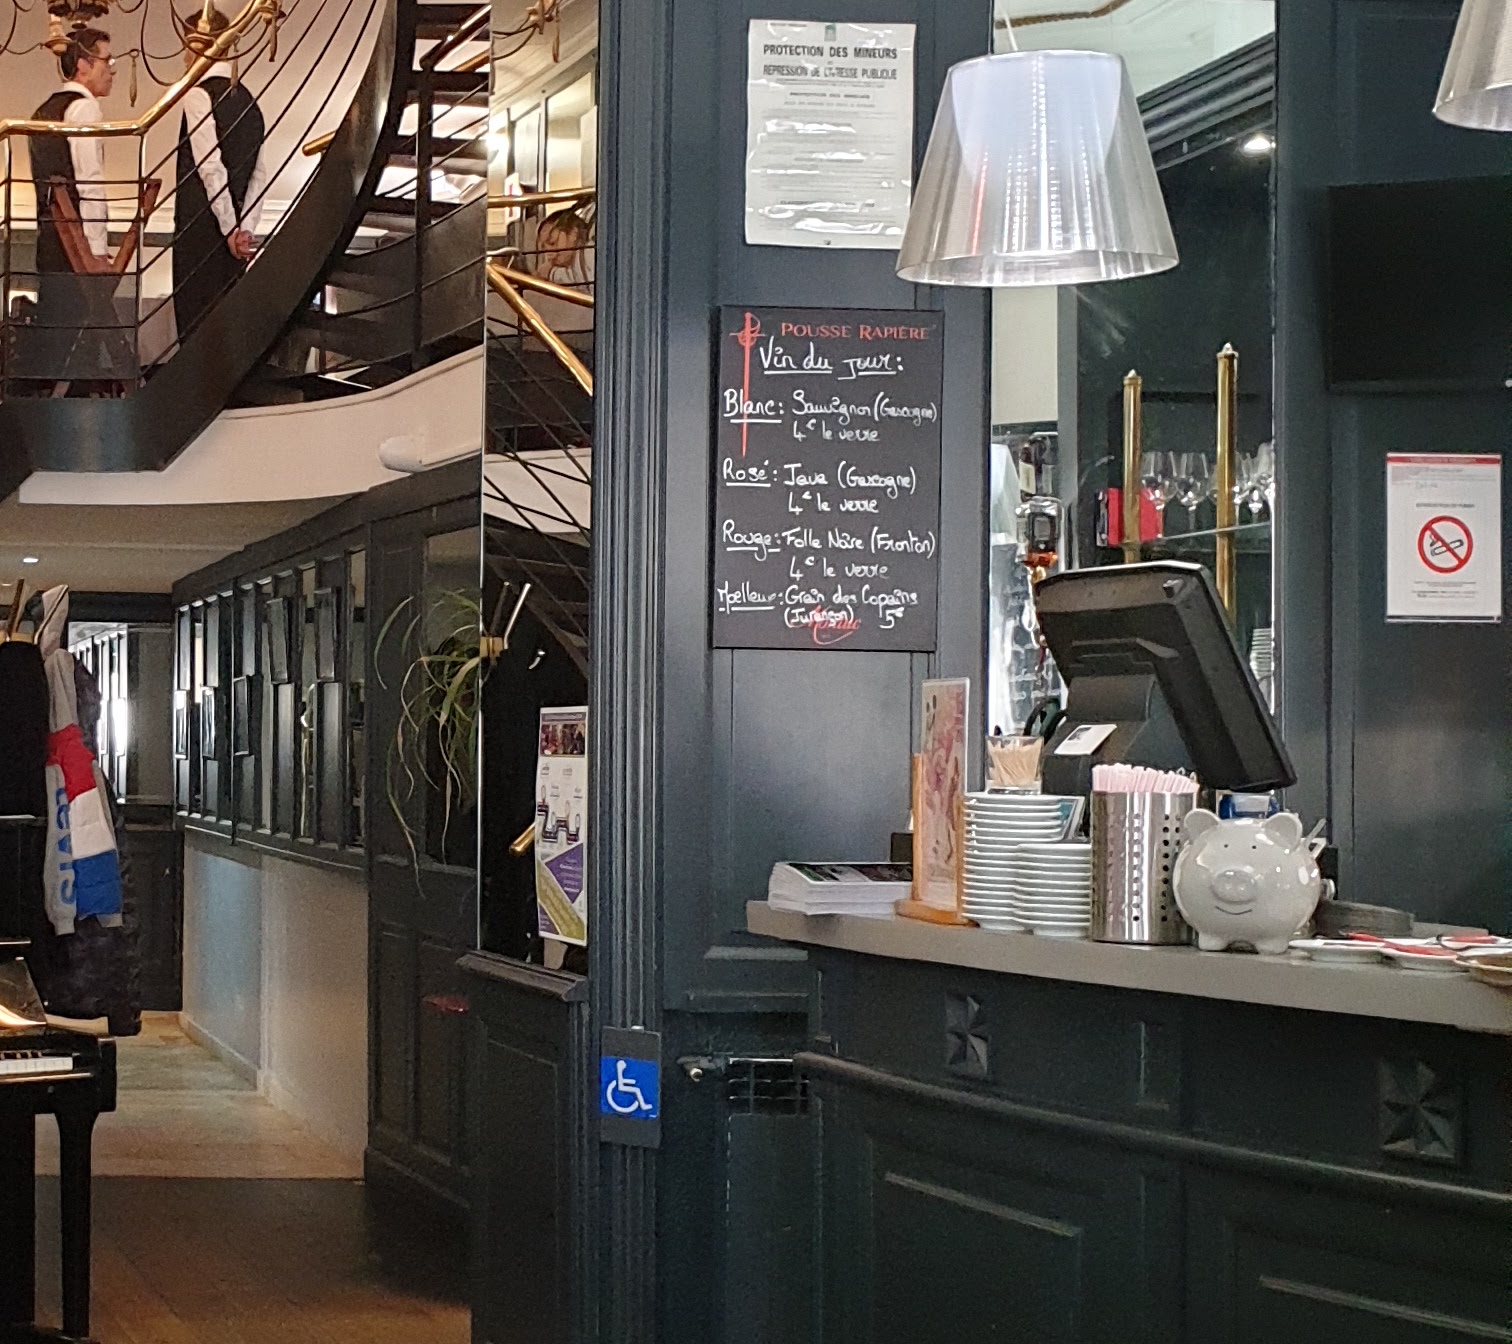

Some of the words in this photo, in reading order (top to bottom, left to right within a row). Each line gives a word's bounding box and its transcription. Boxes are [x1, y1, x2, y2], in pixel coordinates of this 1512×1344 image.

[763, 44, 824, 57] PROTECTION
[829, 46, 848, 58] DES
[854, 47, 898, 60] MINEURS
[781, 322, 852, 338] POUSSE
[760, 335, 797, 369] Vin
[803, 341, 833, 370] du
[792, 389, 871, 425] Sauvignon
[821, 419, 833, 440] le
[838, 428, 881, 442] verre
[817, 492, 831, 512] le
[839, 499, 880, 513] verre
[781, 526, 823, 548] Folle
[828, 527, 865, 550] Noire
[823, 556, 836, 577] le
[844, 563, 890, 579] verre
[785, 584, 825, 605] Grain
[832, 583, 858, 604] des
[861, 583, 918, 618] Copains
